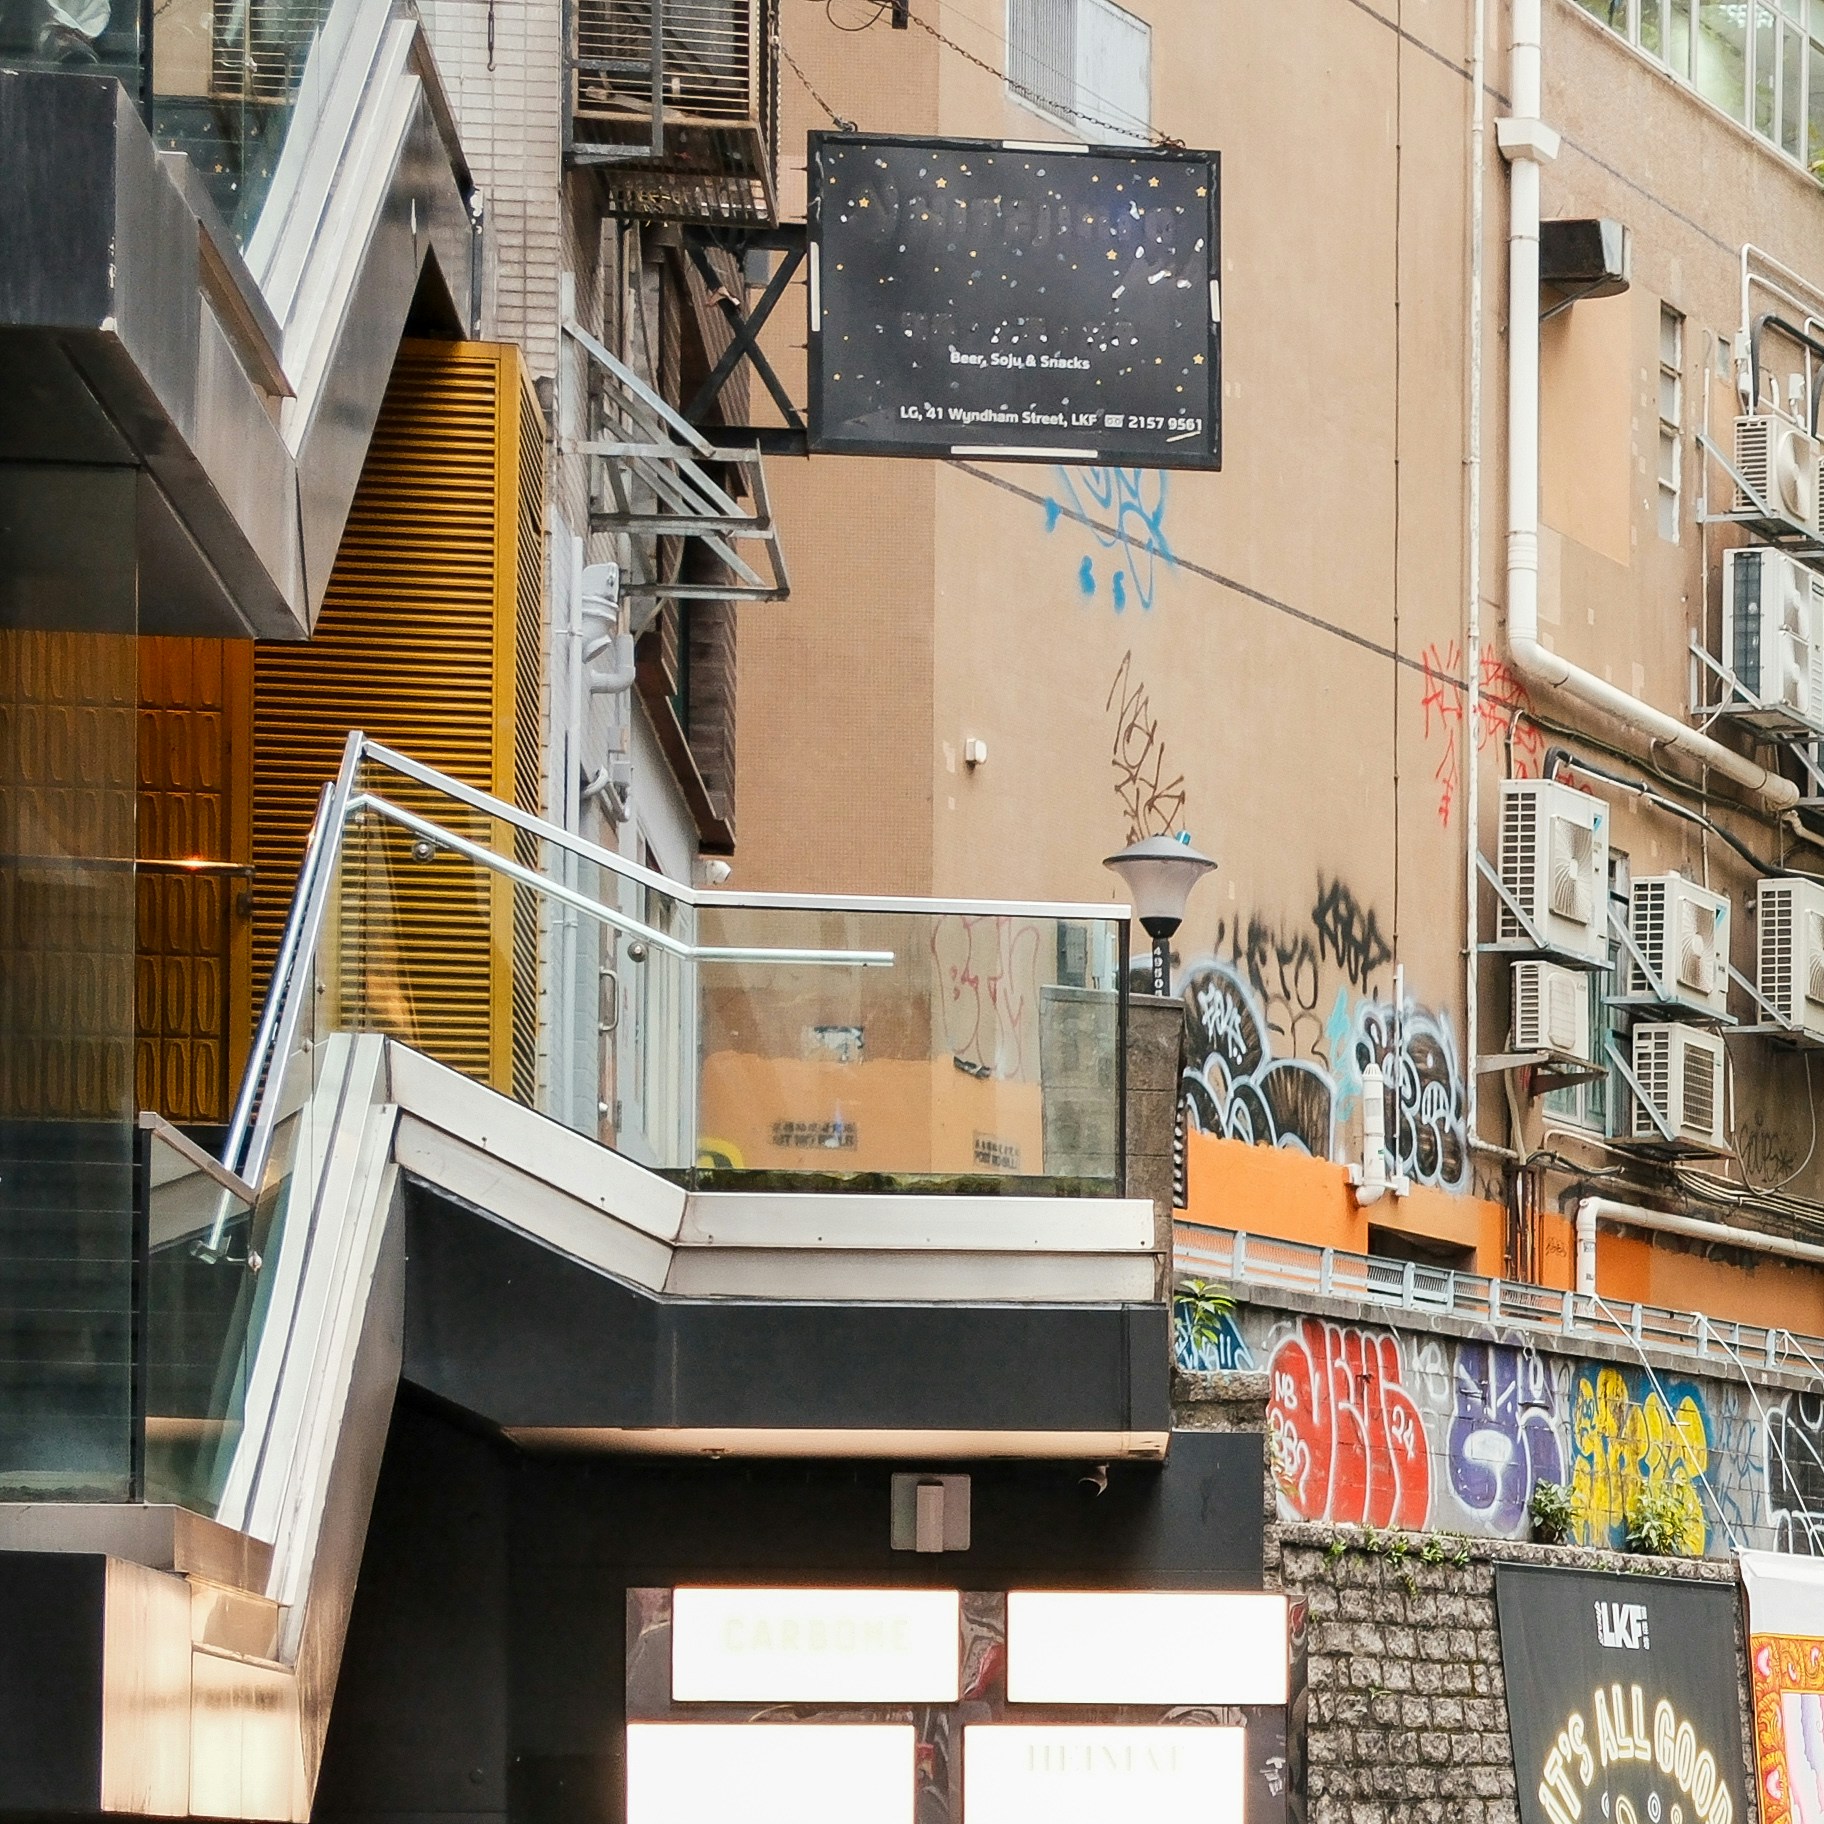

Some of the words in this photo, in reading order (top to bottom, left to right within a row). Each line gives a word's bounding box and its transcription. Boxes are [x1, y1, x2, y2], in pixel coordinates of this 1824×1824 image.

[1025, 355, 1036, 369] &
[1041, 355, 1090, 370] Snacks
[901, 406, 922, 422] LG,
[926, 407, 944, 421] 41
[948, 407, 1018, 425] Wyndham
[1022, 410, 1067, 427] Street,
[1072, 412, 1098, 427] LKF
[1128, 415, 1165, 431] 2157
[1594, 1683, 1652, 1767] ALL
